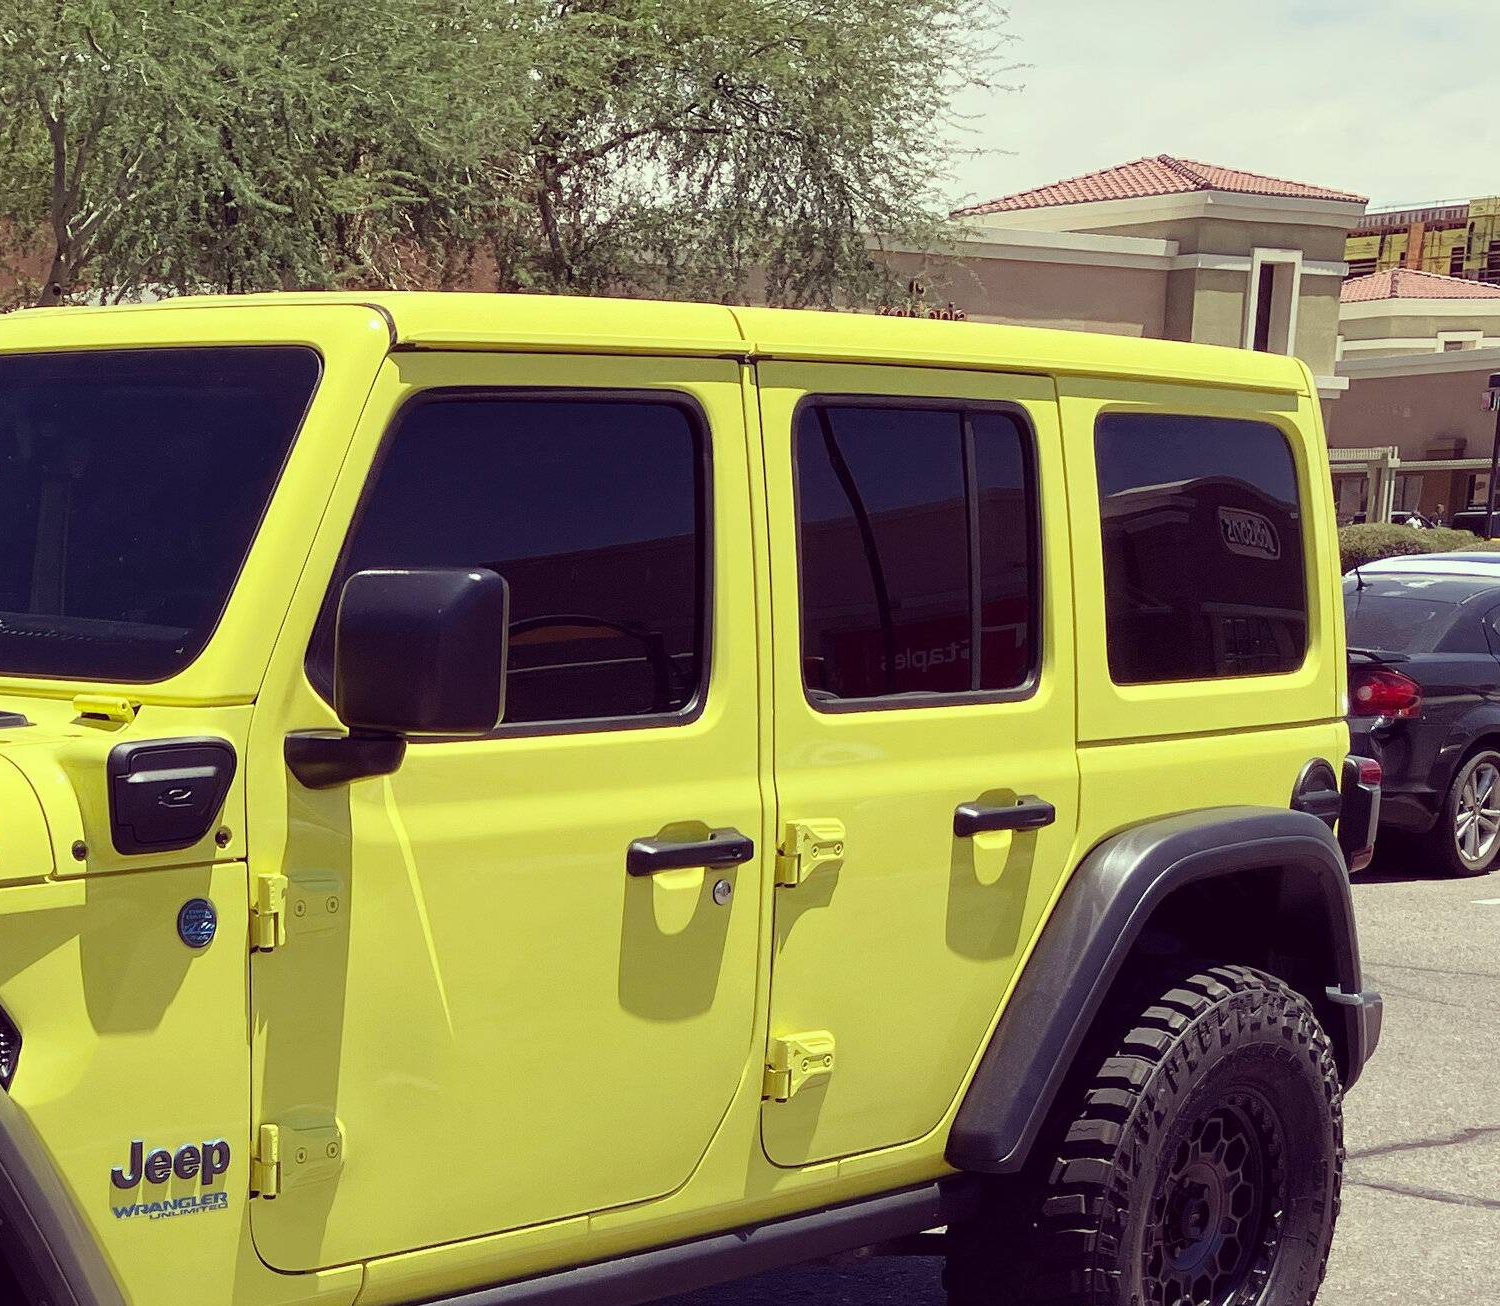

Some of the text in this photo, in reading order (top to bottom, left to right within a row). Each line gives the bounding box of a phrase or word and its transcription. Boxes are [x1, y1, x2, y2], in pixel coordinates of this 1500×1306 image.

[110, 1137, 231, 1189] Jeep
[112, 1191, 228, 1219] WRANGLER
[148, 1202, 229, 1220] UNLIMITED
